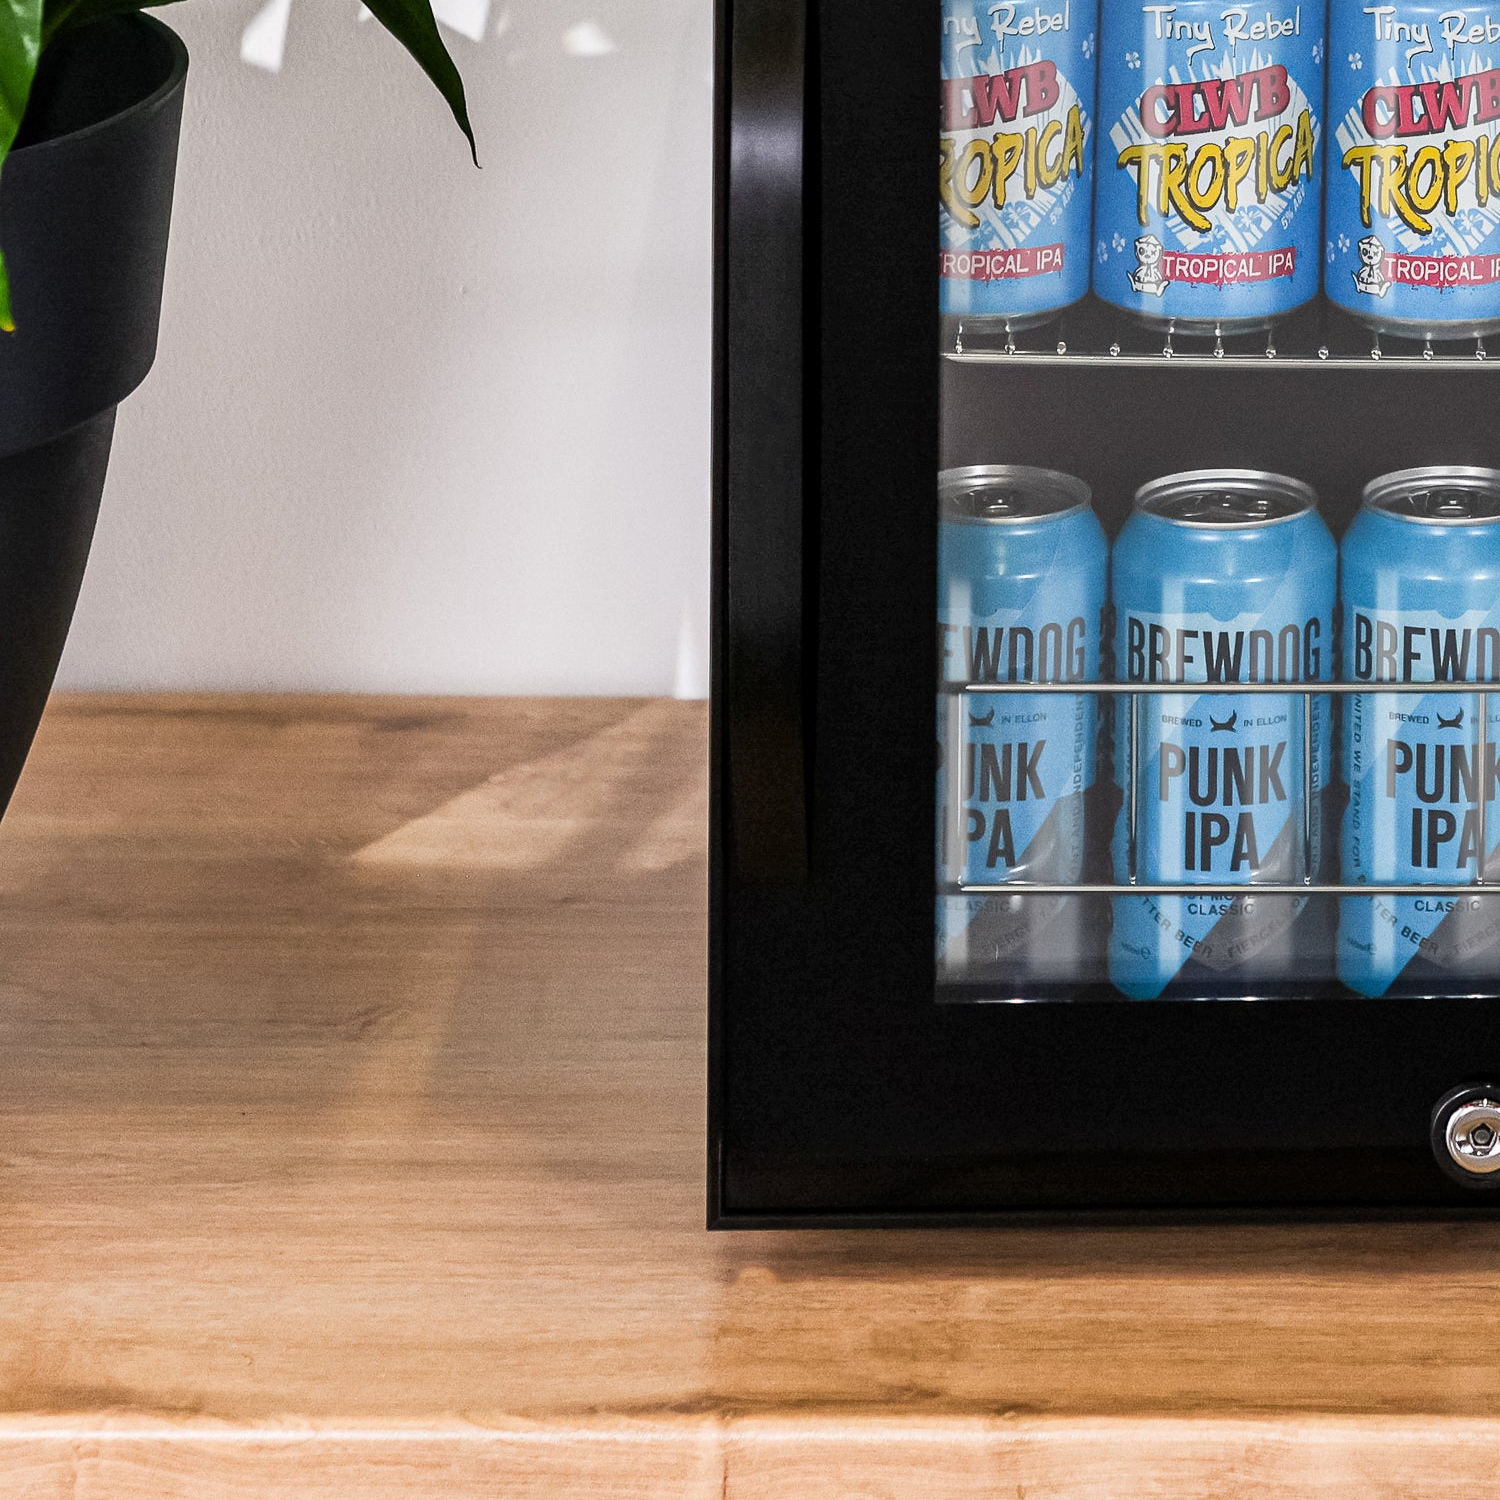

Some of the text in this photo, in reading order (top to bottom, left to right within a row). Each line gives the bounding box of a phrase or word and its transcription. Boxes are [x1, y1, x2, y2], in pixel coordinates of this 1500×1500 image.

[943, 0, 1070, 57] ny Rebel
[1142, 5, 1300, 66] Tiny Rebel
[1362, 5, 1434, 68] Tiny
[941, 60, 1060, 132] LWB
[1139, 64, 1291, 139] CLWB
[939, 104, 1085, 229] ROPICA
[1116, 108, 1315, 234] TROPICA
[943, 247, 1062, 274] ROPICAL IPA
[1164, 253, 1294, 278] TROPICAL IPA
[1386, 258, 1483, 281] TROPICAL
[937, 616, 1086, 682] EWDOG
[1128, 617, 1321, 682] BREWDOG
[1015, 712, 1047, 723] ELLON
[1161, 714, 1288, 727] BREWED IN ELLON
[1388, 711, 1430, 725] BREWED
[966, 740, 1047, 801] NK
[1159, 741, 1288, 807] PUNK
[1353, 750, 1362, 772] WE
[1352, 779, 1361, 829] STAND
[1184, 811, 1260, 872] IPA
[1352, 836, 1361, 868] FOR
[1411, 807, 1480, 869] IPA
[1187, 902, 1255, 916] CLASSIC
[1414, 900, 1481, 912] CLASSIC
[1401, 925, 1440, 955] BEER
